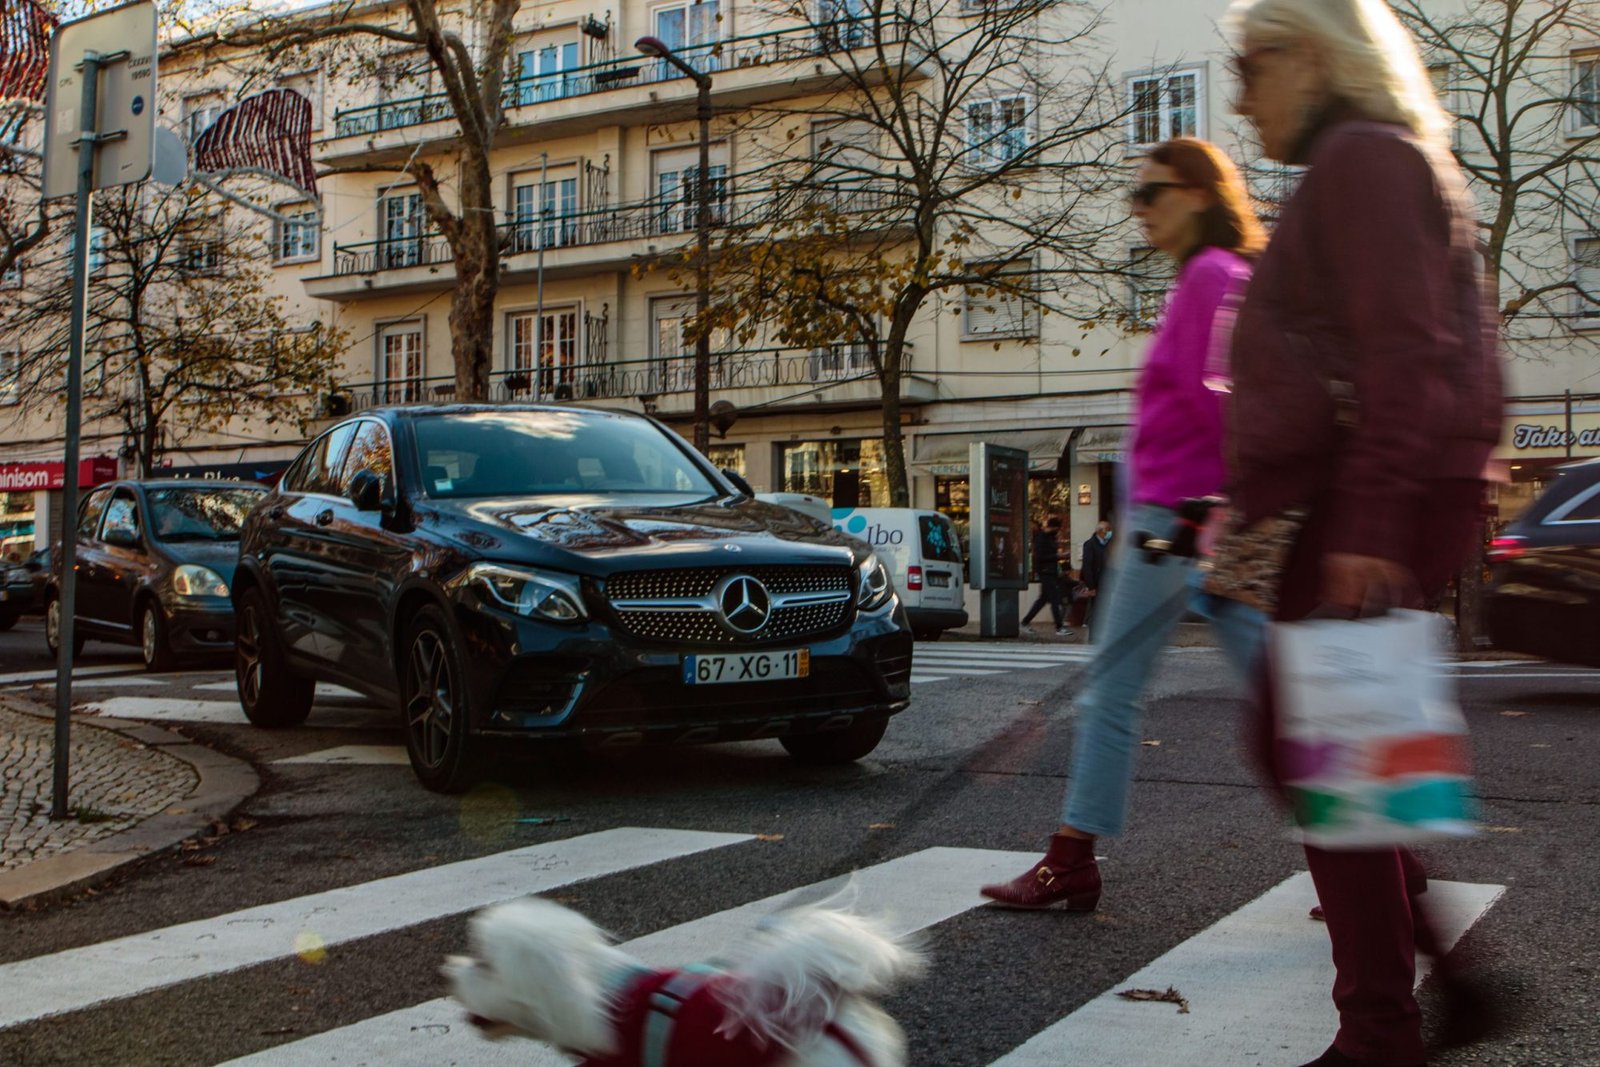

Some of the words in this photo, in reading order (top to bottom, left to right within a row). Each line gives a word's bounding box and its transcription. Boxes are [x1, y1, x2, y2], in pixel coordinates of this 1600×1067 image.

[1513, 424, 1576, 449] Take
[0, 467, 48, 488] inisom
[867, 523, 904, 546] Ibo
